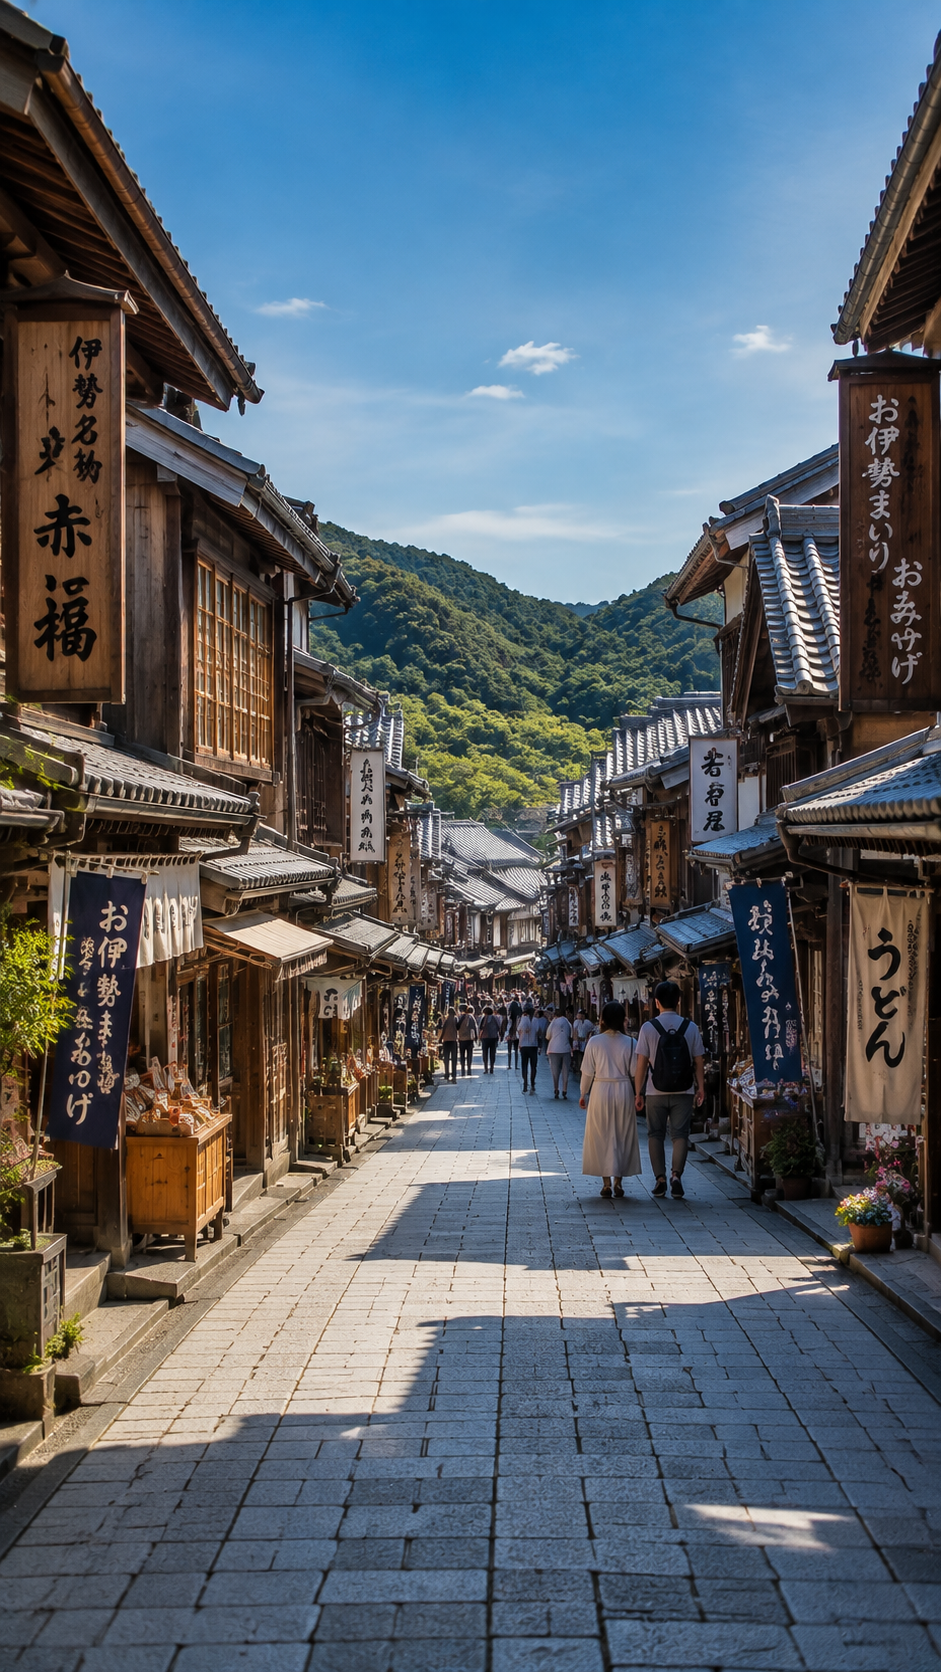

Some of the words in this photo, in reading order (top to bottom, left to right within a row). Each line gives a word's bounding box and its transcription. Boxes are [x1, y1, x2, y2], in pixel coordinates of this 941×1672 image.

[862, 394, 900, 573] お伊勢まいり
[34, 494, 97, 662] 赤福
[866, 927, 906, 1068] うどん
